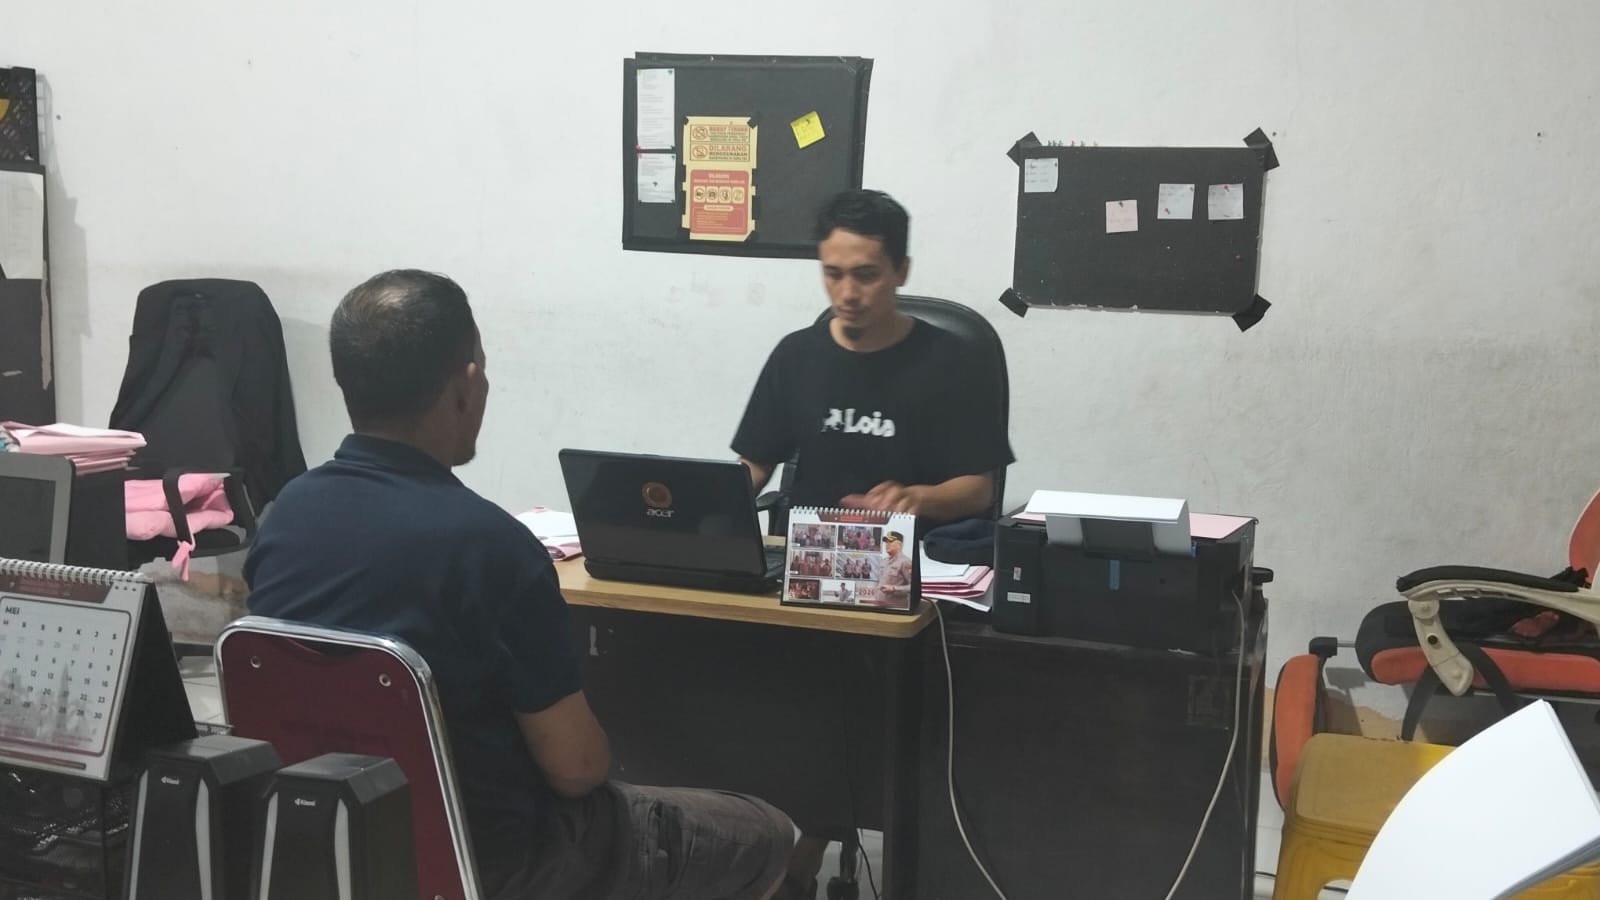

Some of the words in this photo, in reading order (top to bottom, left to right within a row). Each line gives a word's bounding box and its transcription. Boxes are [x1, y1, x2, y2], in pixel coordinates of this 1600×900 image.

[843, 408, 895, 437] Lois
[647, 508, 674, 518] acer
[5, 606, 20, 615] MEI
